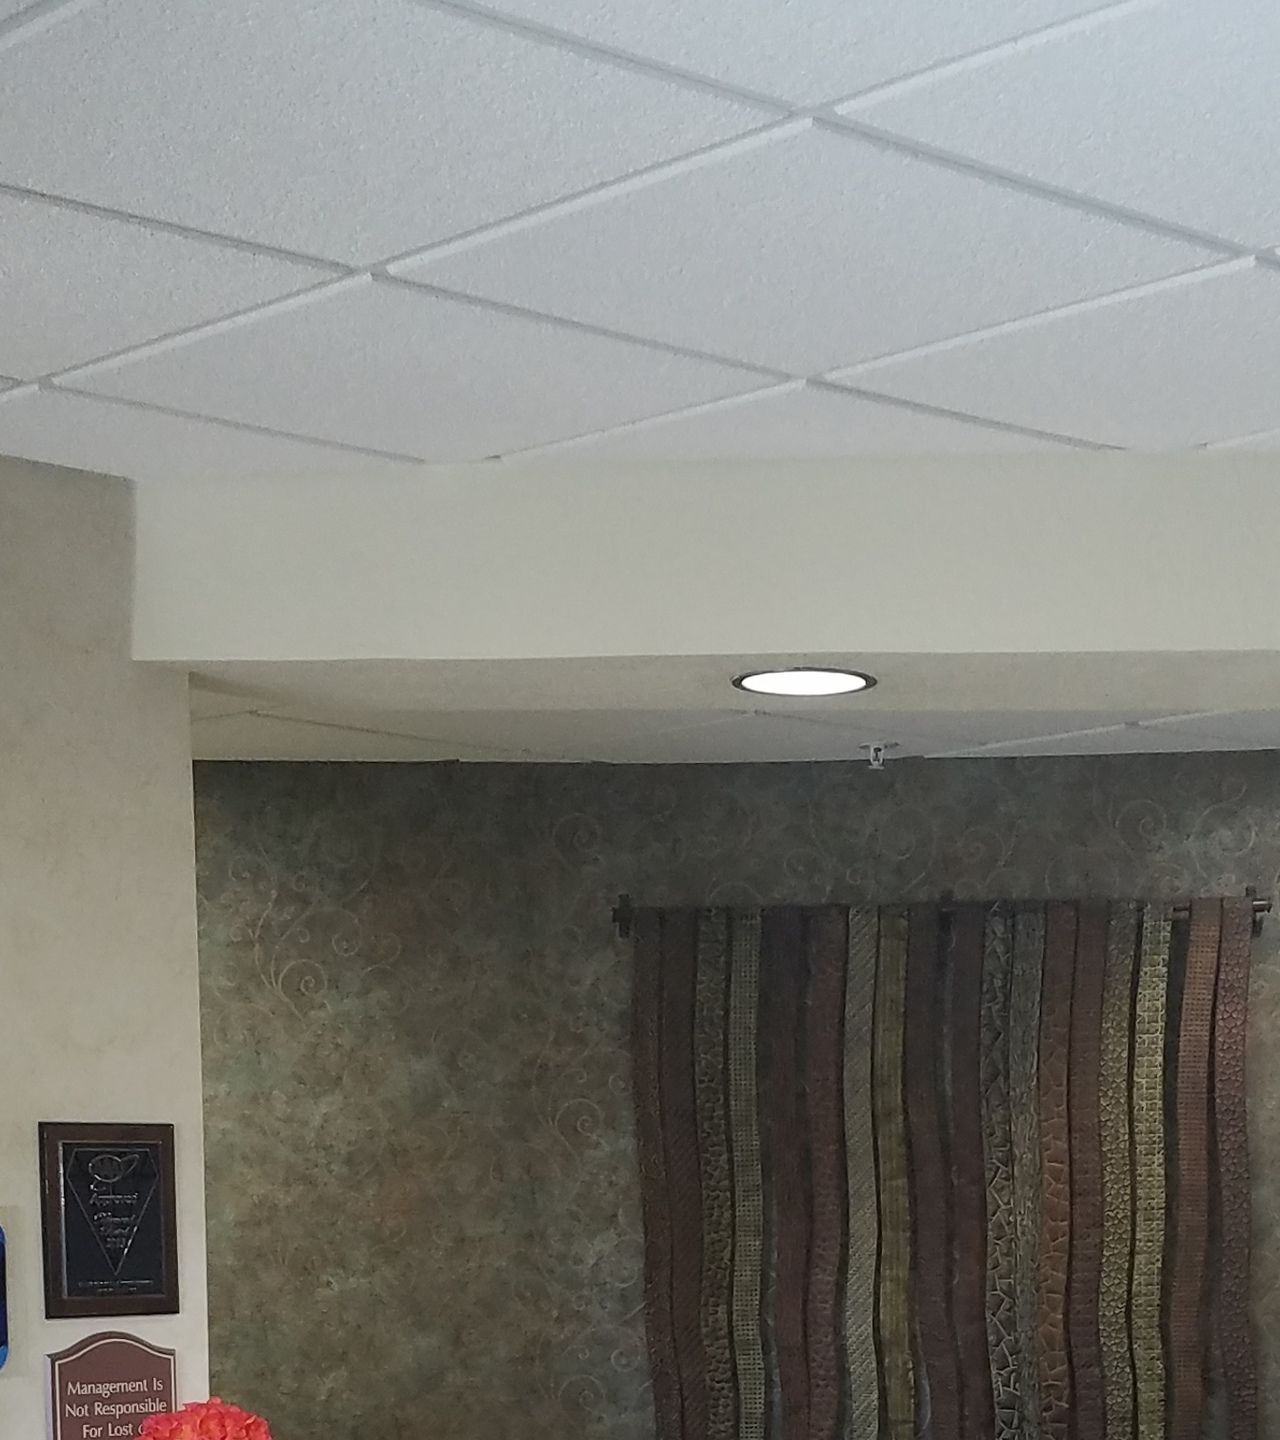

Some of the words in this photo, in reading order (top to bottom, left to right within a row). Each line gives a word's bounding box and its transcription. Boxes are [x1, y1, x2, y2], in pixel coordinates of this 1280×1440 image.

[67, 1379, 148, 1398] Management
[153, 1377, 163, 1391] Is
[65, 1403, 89, 1417] Not
[94, 1397, 167, 1419] Responsible
[83, 1424, 103, 1438] For
[108, 1423, 133, 1437] Lost
